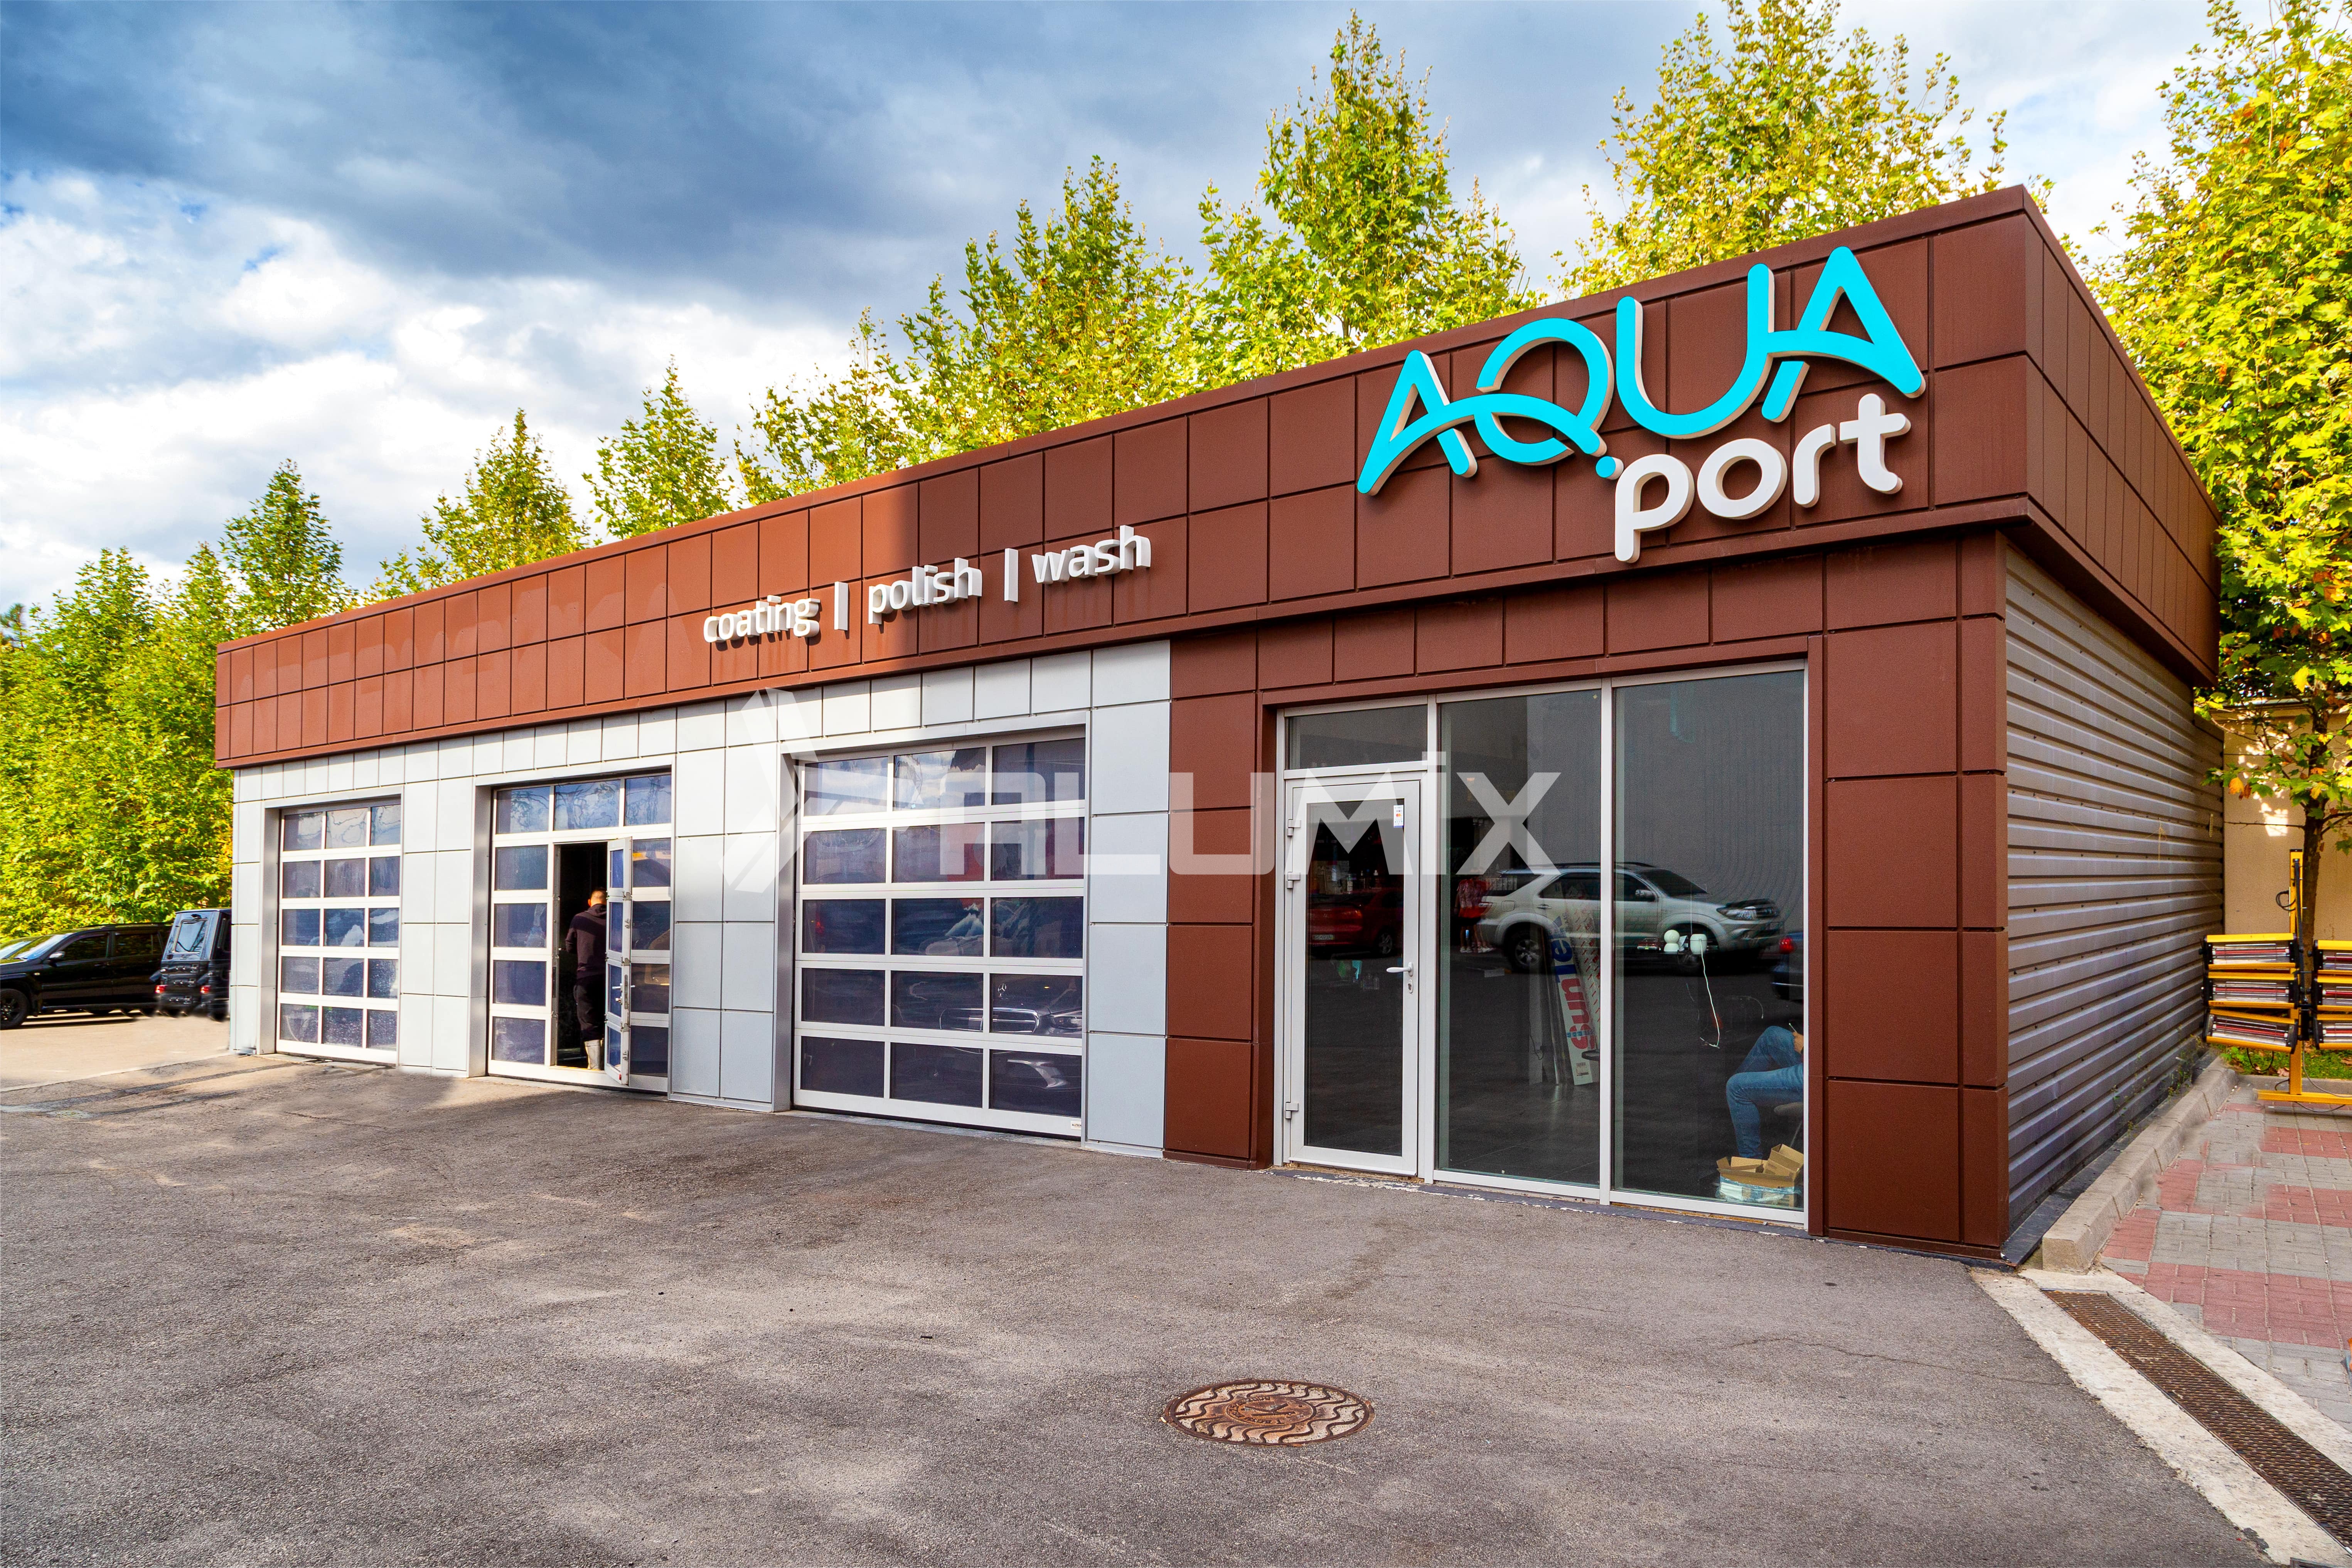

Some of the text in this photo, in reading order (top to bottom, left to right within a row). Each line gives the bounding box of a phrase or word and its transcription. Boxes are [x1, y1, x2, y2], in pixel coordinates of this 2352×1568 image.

[1357, 246, 1926, 496] AQUA
[1614, 393, 1911, 563] port
[703, 595, 821, 643] coating
[868, 557, 982, 625] polish
[1031, 525, 1151, 584] wash
